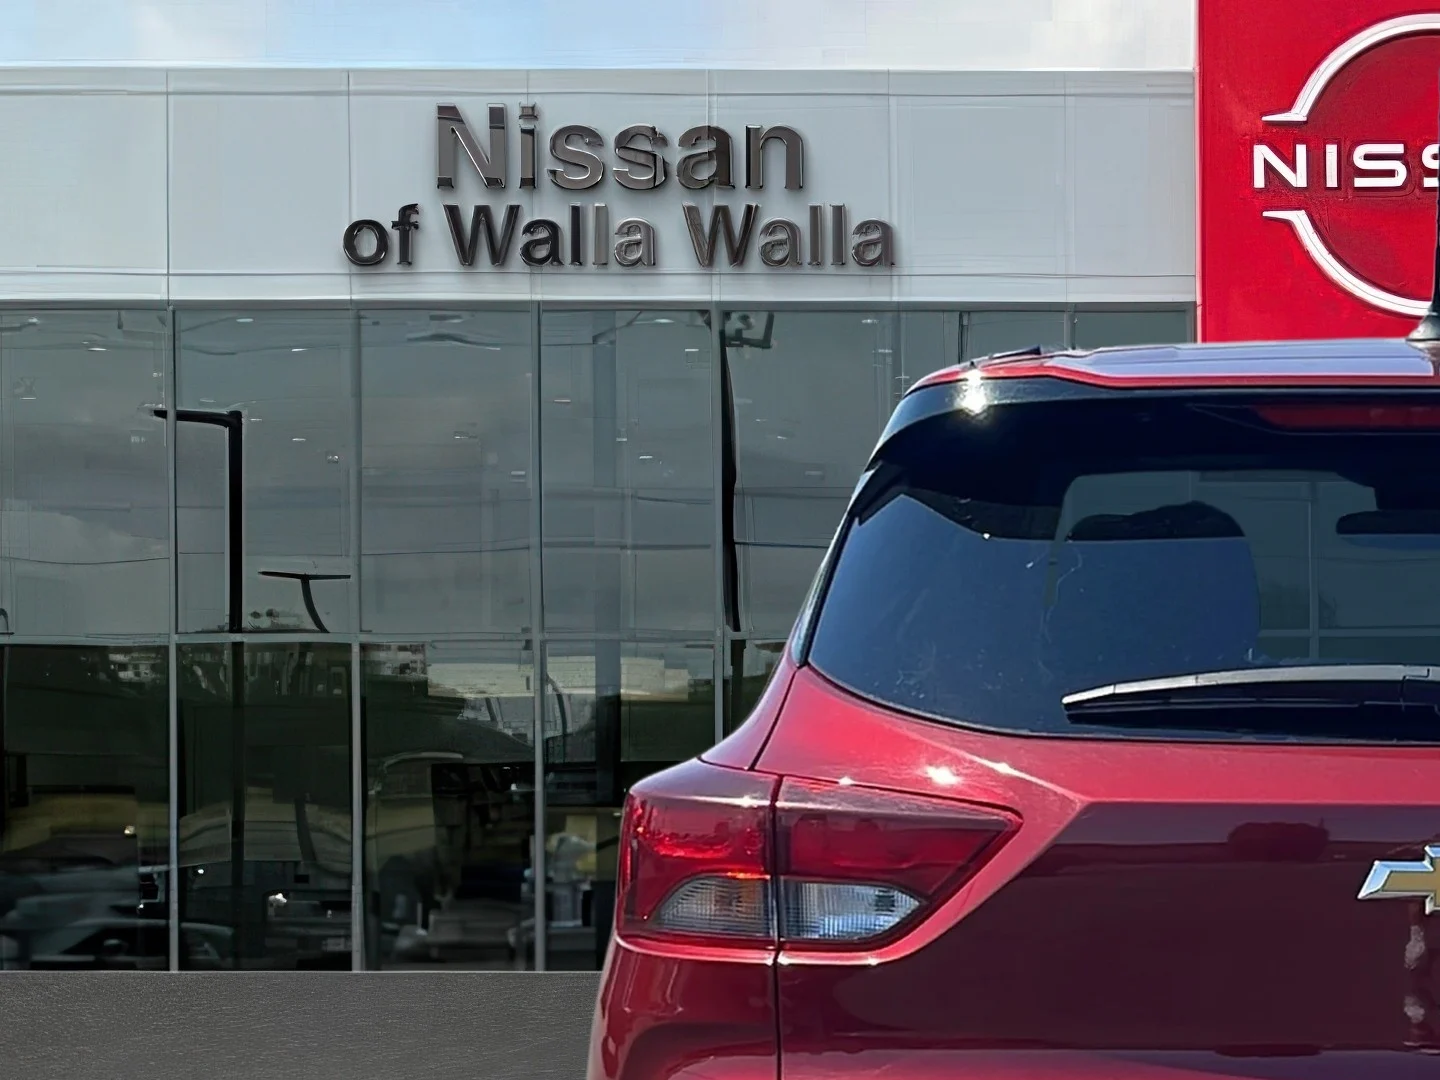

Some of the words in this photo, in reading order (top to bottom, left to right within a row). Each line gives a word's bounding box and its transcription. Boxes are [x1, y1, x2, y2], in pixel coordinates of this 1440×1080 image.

[436, 102, 803, 190] Nissan
[342, 203, 420, 266] of
[441, 202, 657, 266] Walla
[682, 202, 896, 267] Walla
